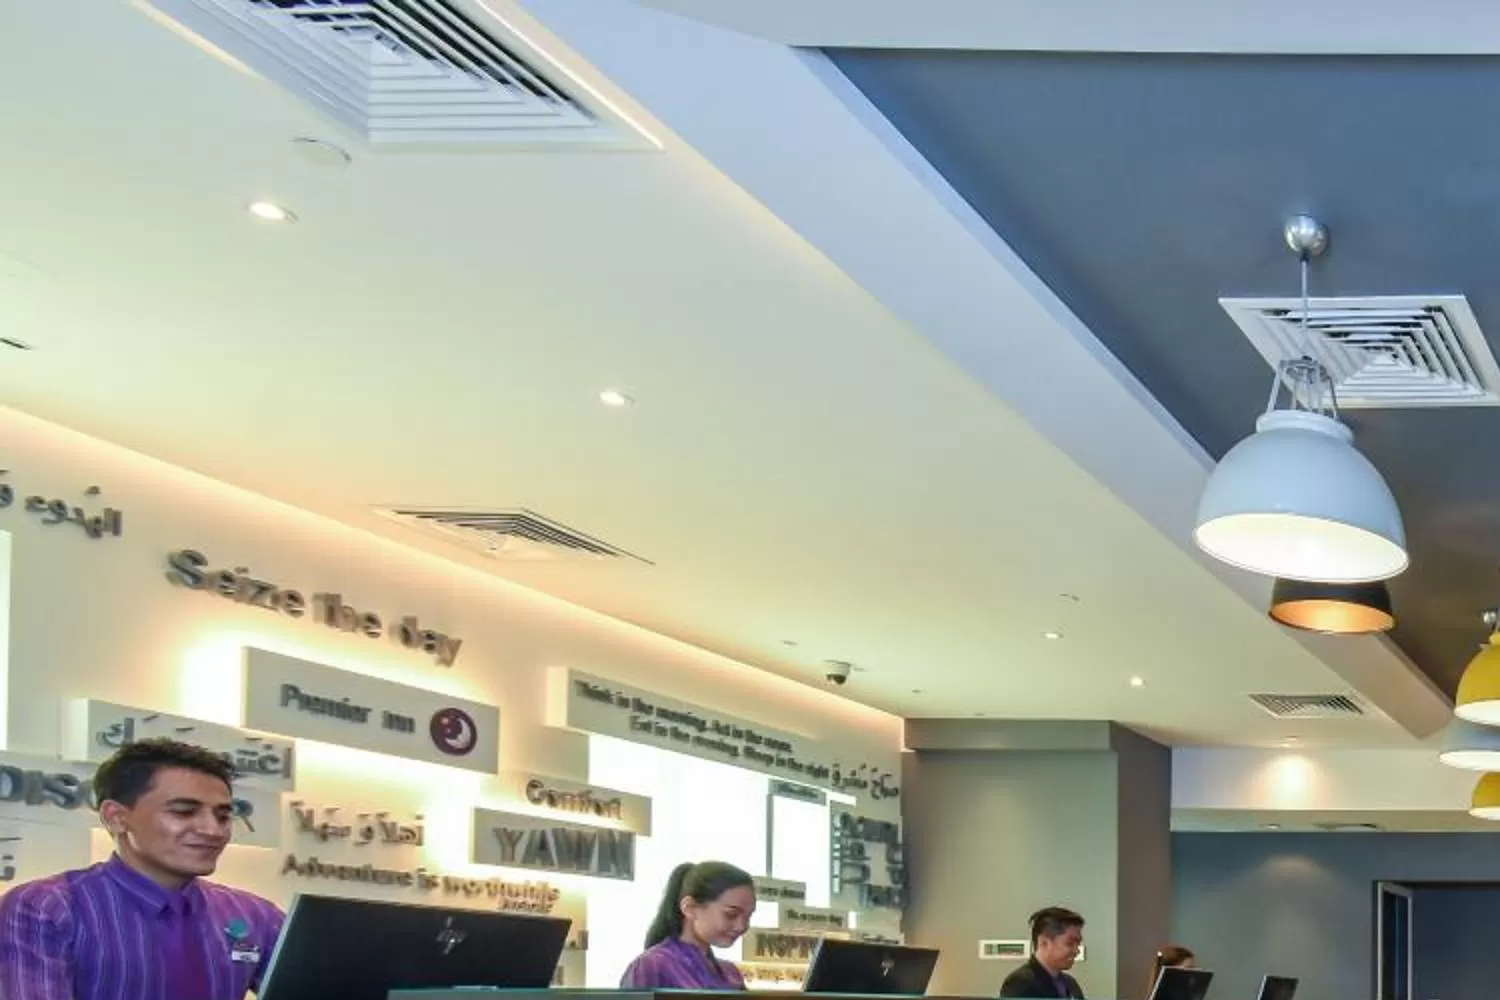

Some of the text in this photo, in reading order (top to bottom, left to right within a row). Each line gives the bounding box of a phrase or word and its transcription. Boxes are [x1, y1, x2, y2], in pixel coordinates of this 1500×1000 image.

[165, 549, 305, 618] Seize
[388, 616, 463, 668] day
[280, 683, 416, 734] Premier Inn
[526, 779, 623, 820] Comfort
[492, 827, 635, 880] YAWN
